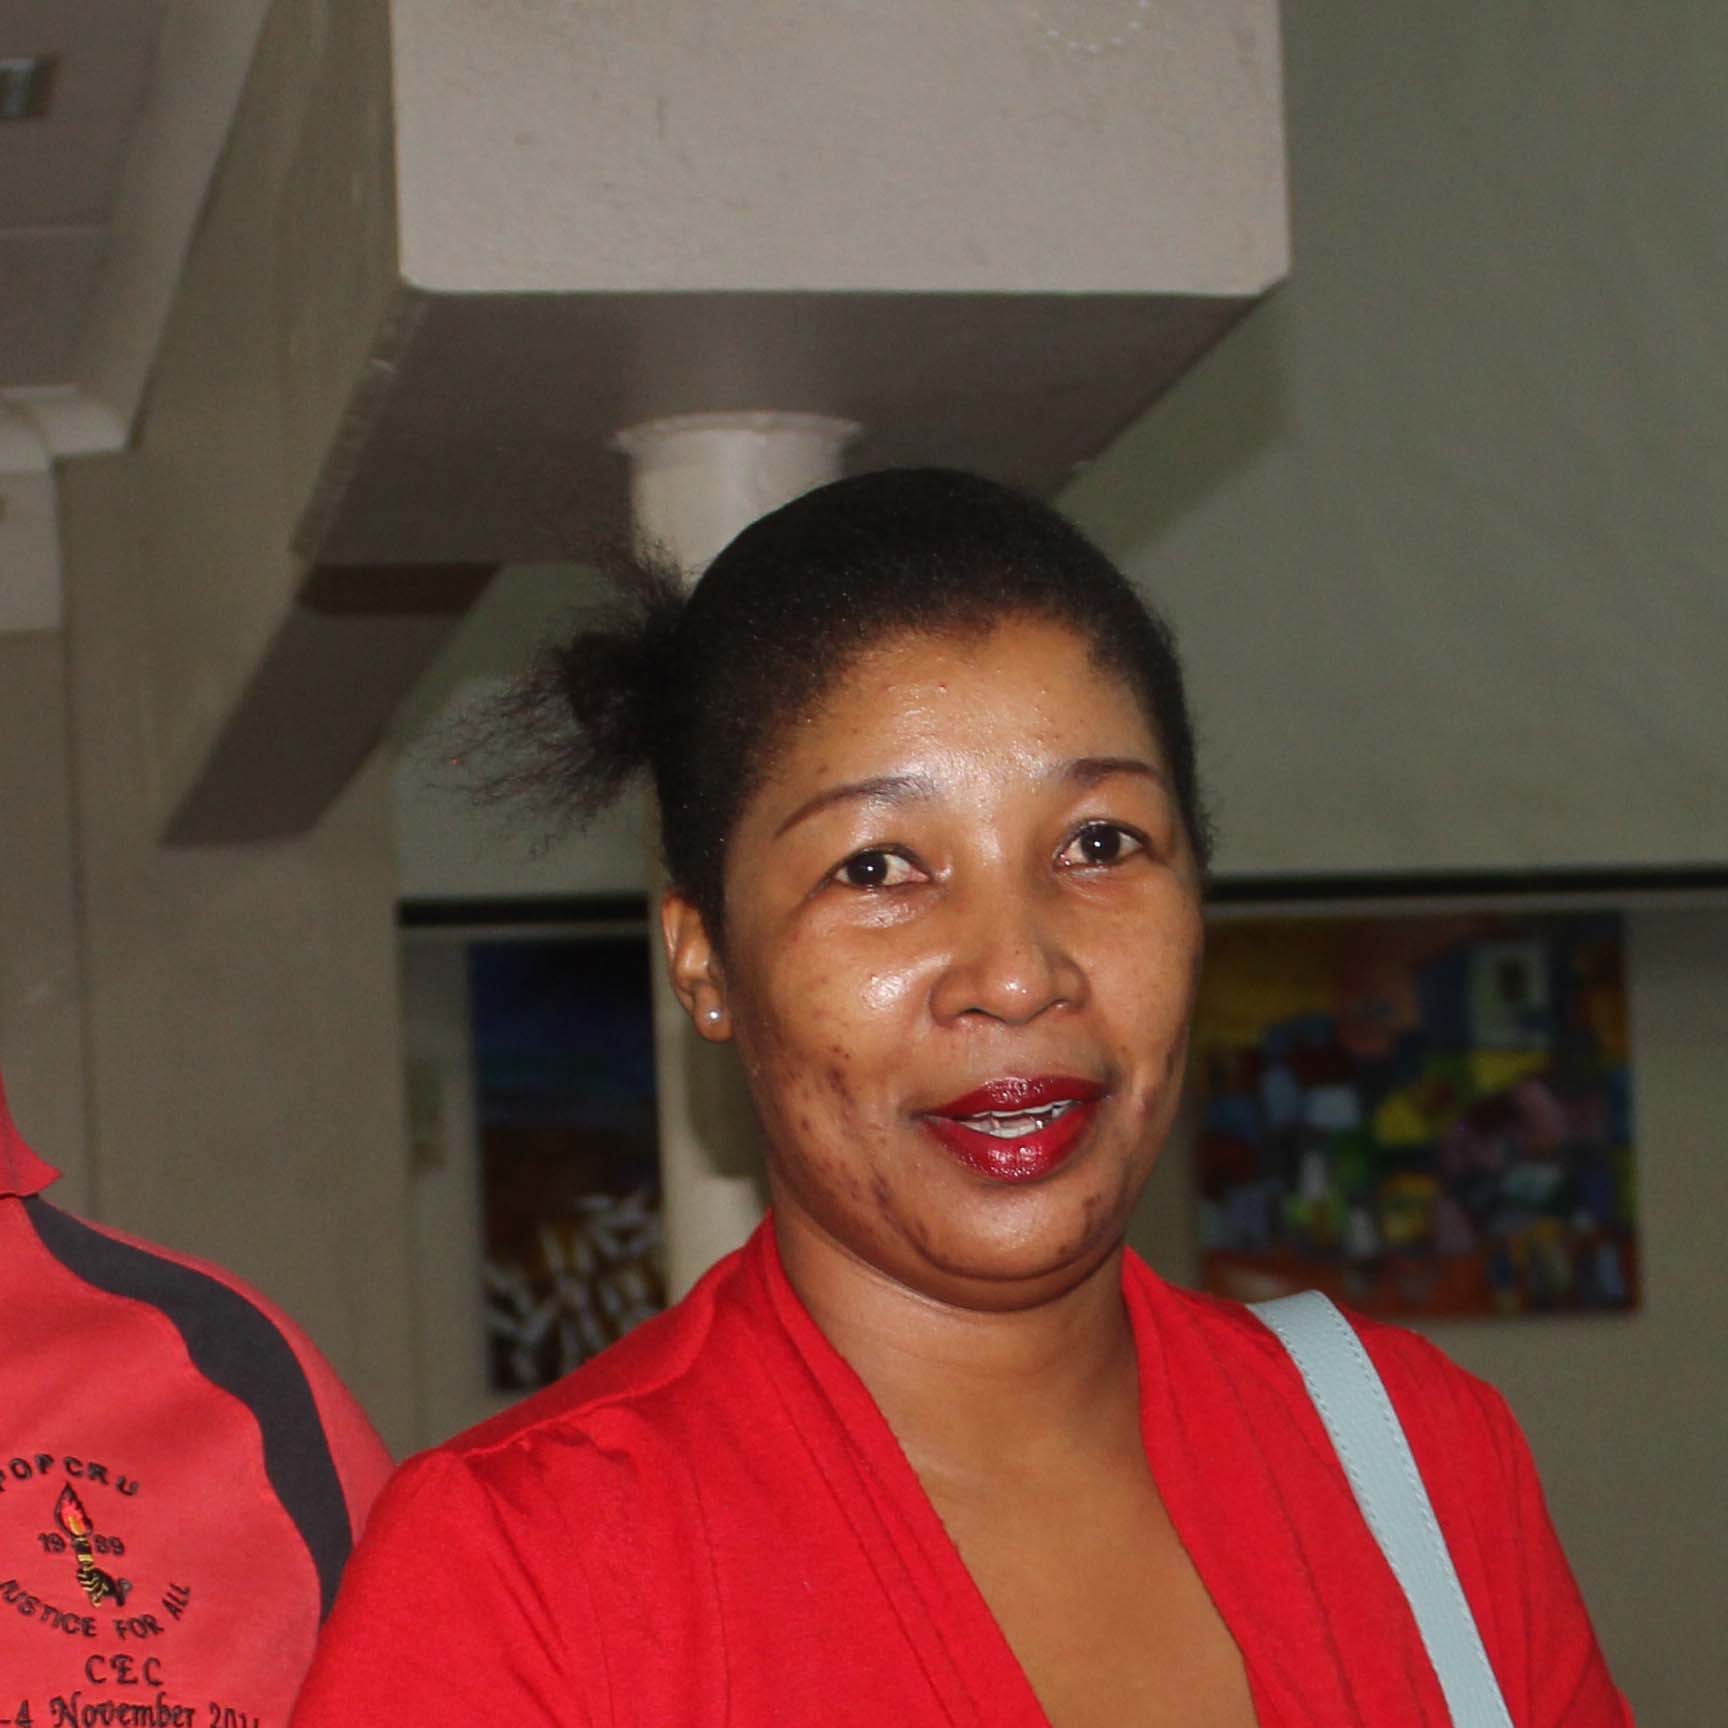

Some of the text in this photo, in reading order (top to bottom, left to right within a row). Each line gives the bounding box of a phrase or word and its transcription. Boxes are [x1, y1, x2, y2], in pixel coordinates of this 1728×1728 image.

[38, 1532, 67, 1553] 19
[113, 1613, 165, 1640] FOR
[161, 1582, 191, 1621] ALL
[85, 1654, 164, 1687] CEC
